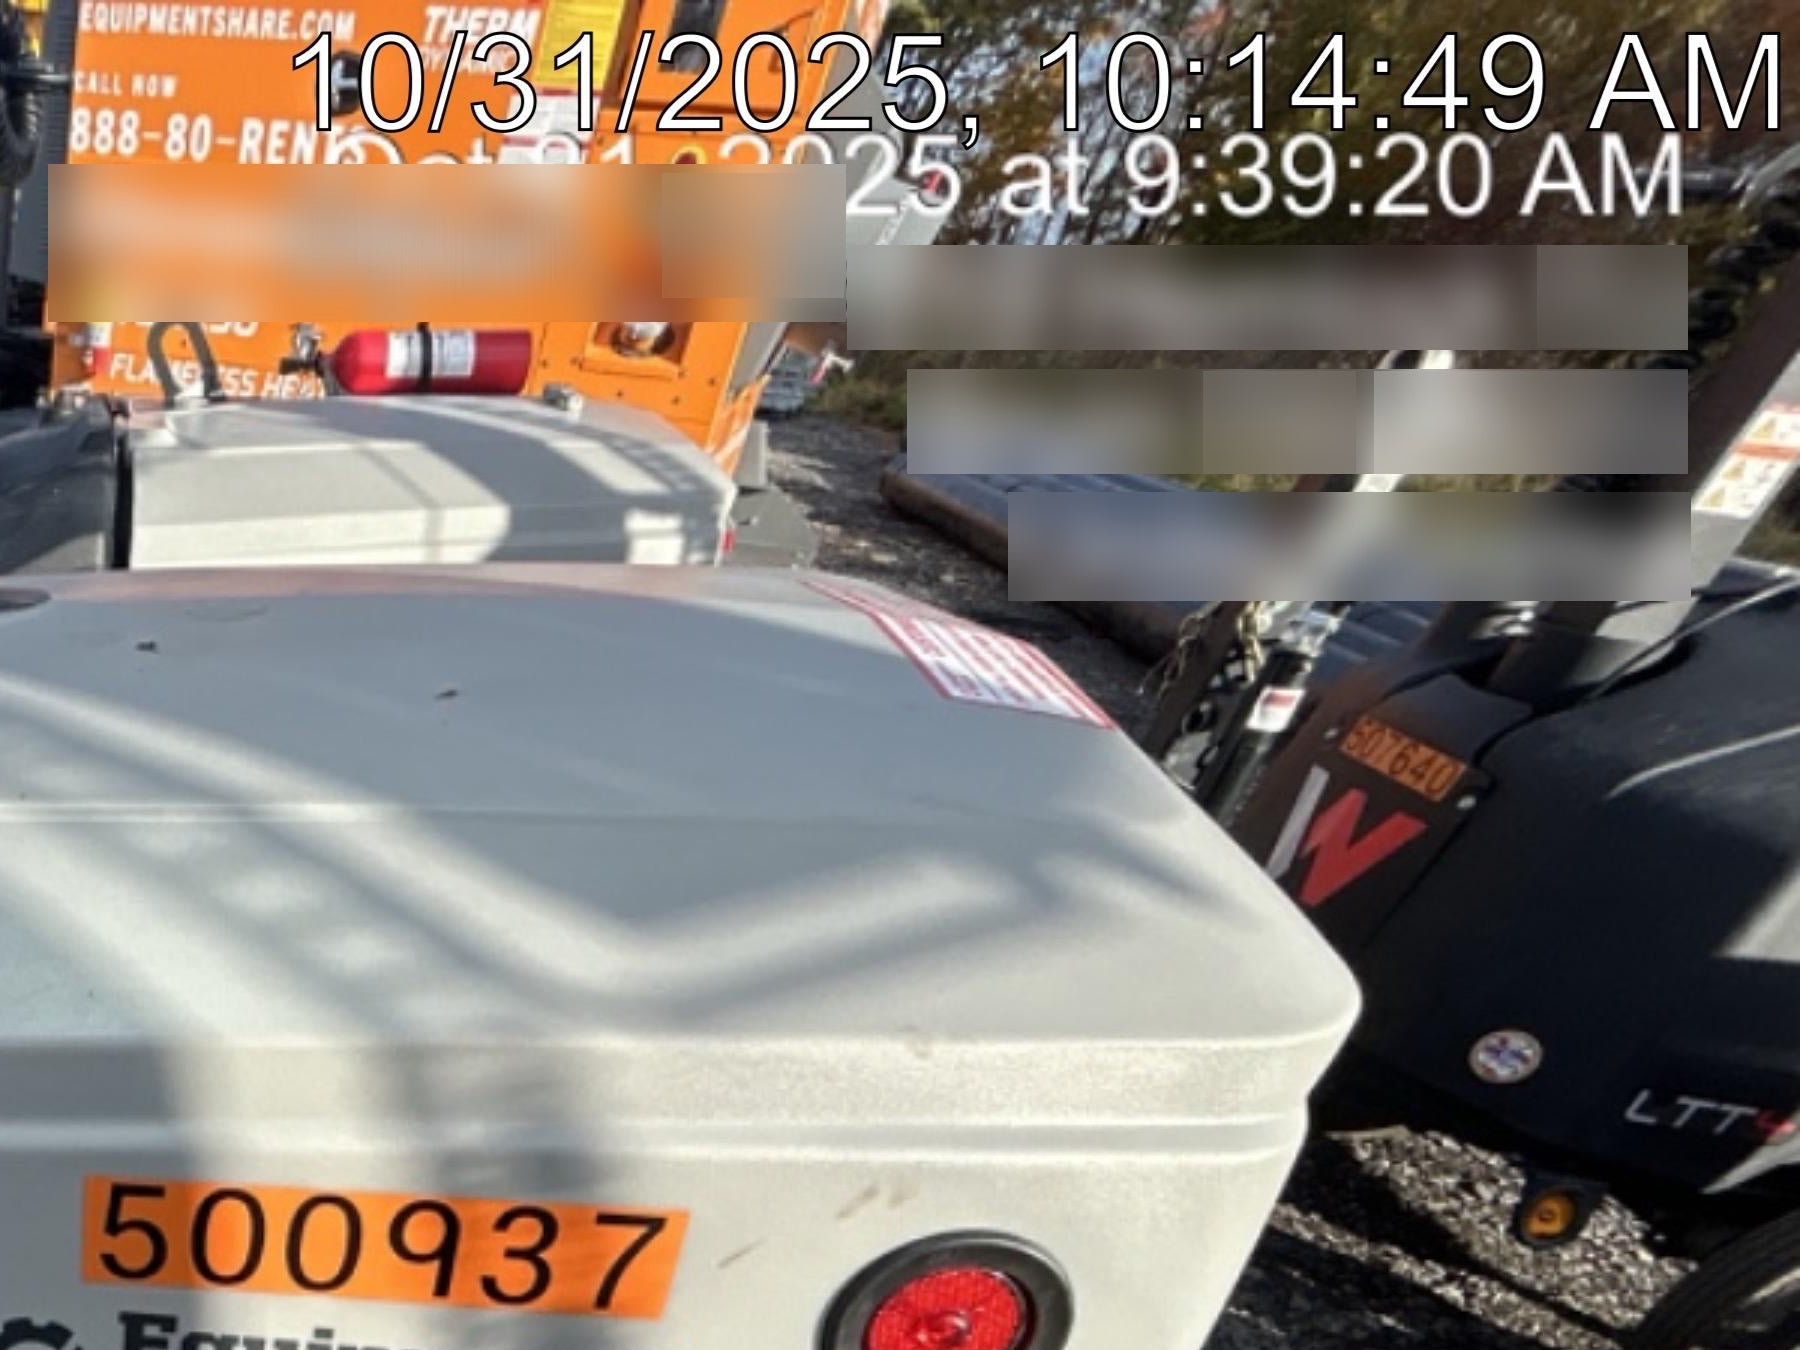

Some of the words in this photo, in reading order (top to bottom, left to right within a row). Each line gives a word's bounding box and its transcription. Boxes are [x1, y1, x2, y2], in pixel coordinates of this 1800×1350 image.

[79, 3, 355, 42] EQUIPMENTSHARE.COM
[422, 4, 541, 46] THERM
[73, 70, 123, 97] CALL
[132, 73, 178, 98] NOW
[98, 1182, 667, 1312] 500937
